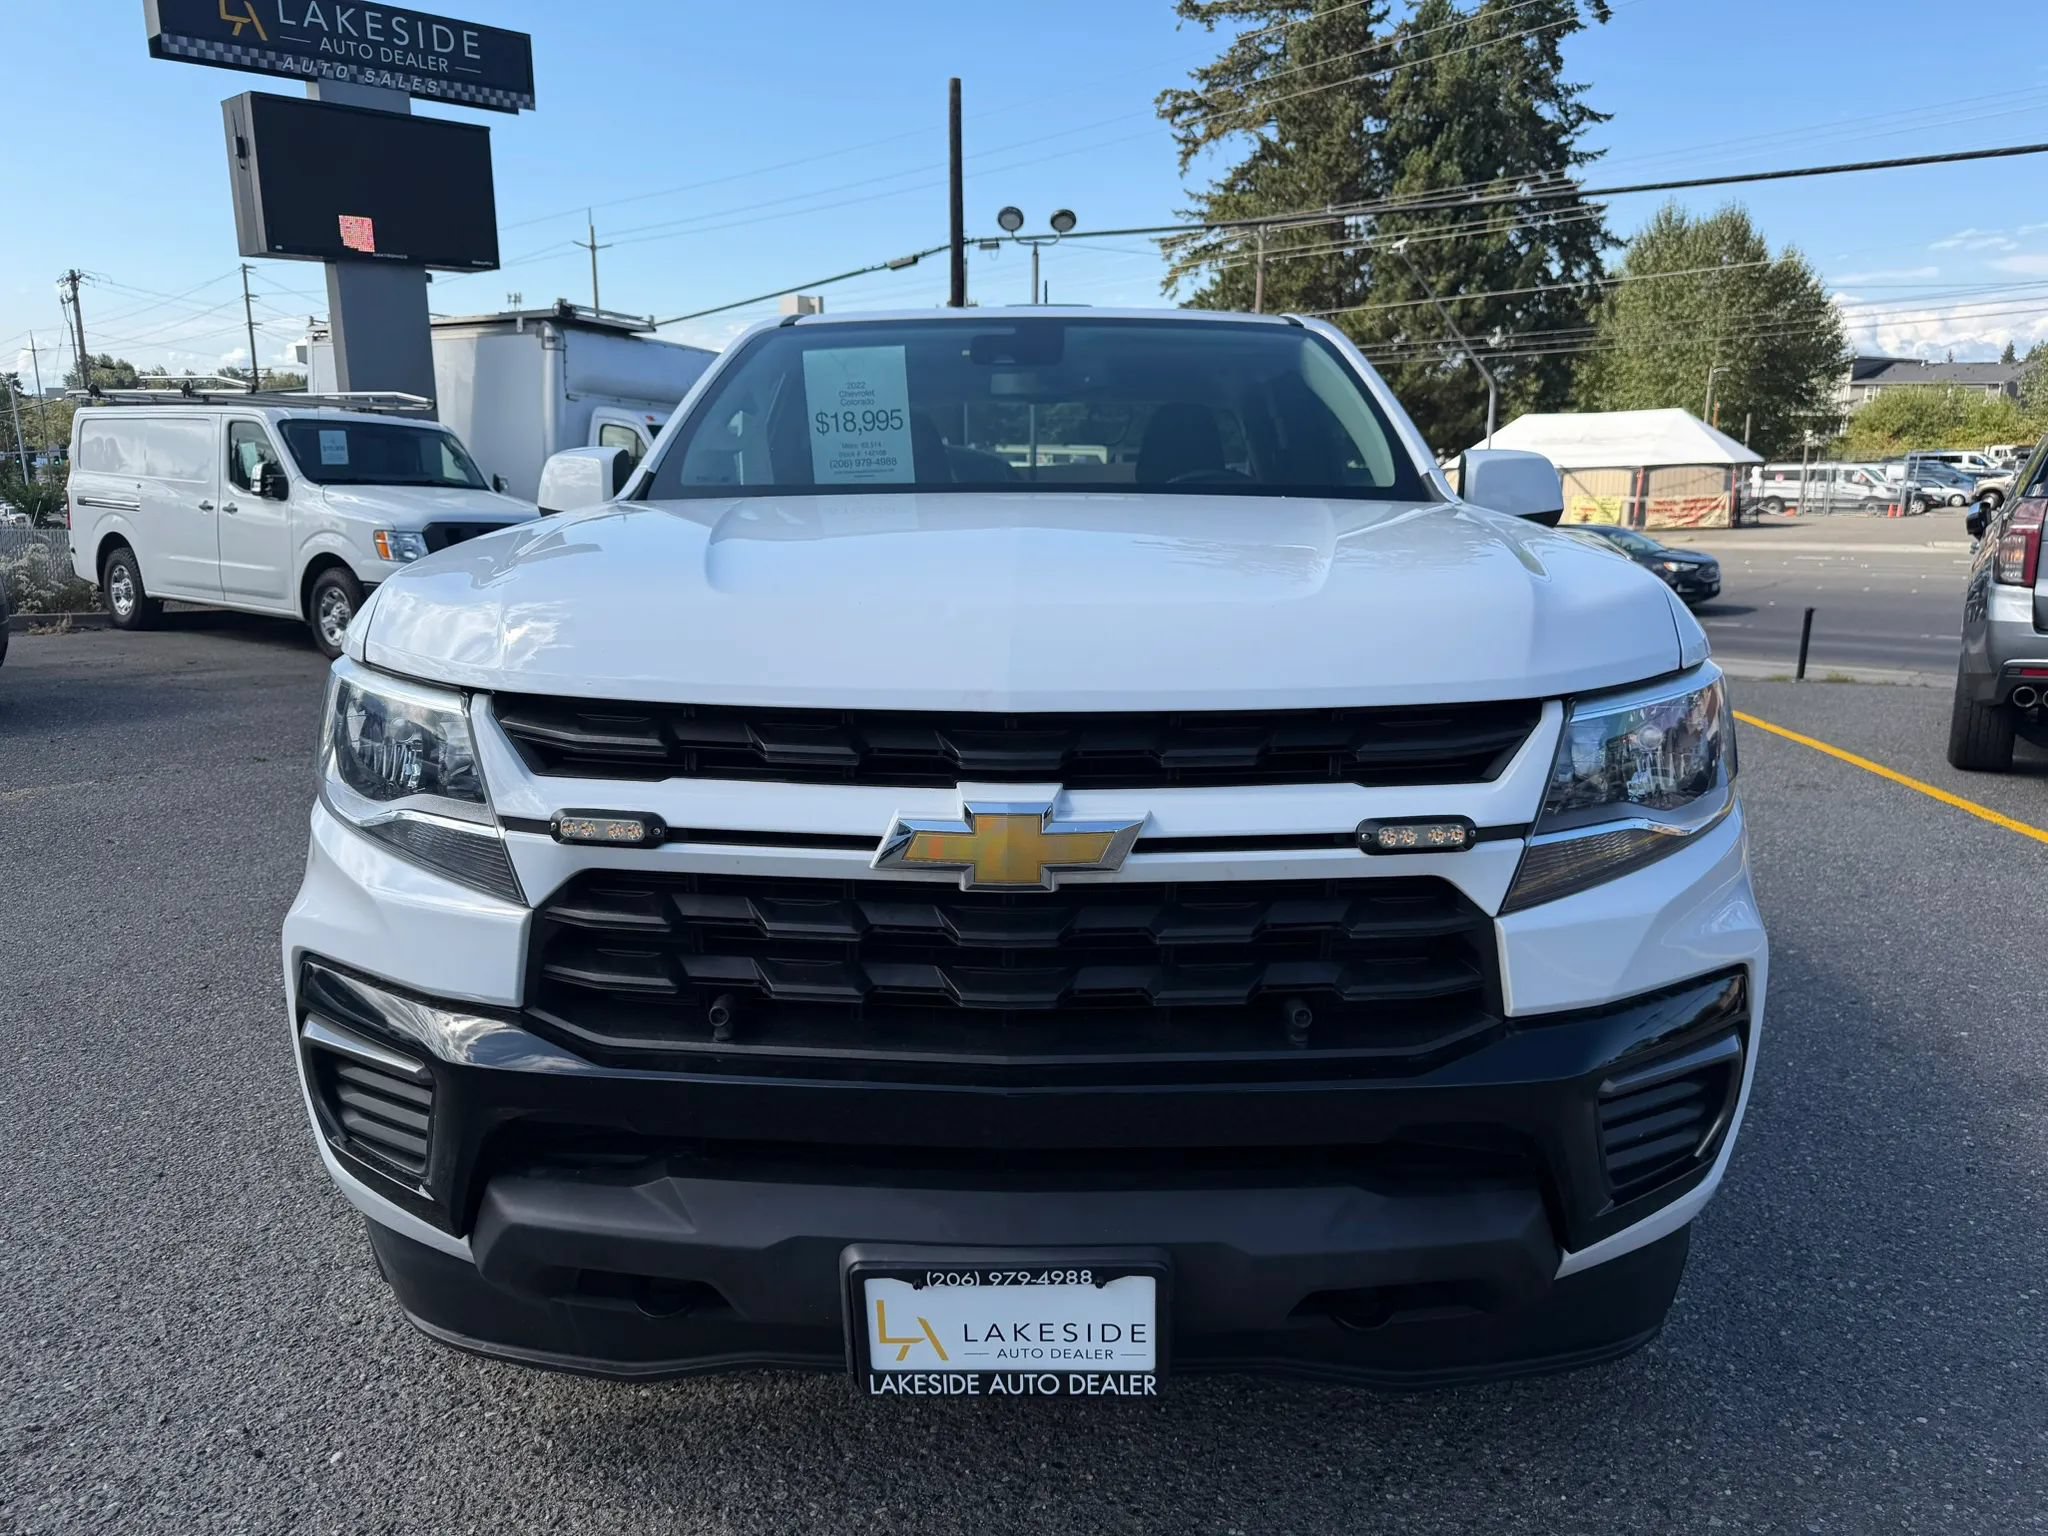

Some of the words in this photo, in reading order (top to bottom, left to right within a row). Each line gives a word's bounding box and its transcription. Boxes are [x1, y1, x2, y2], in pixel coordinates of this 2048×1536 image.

[277, 0, 481, 60] LAKESIDE
[319, 37, 373, 60] AUTO
[380, 47, 449, 73] DEALER
[281, 56, 348, 79] AUTO
[364, 70, 439, 94] SALES
[839, 389, 875, 399] Chevrolet
[840, 398, 875, 407] Colorado
[815, 409, 904, 436] $18,995
[926, 1271, 980, 1288] (206)
[988, 1269, 1093, 1287] 979-4988
[963, 1322, 1147, 1343] LAKESIDE
[996, 1347, 1044, 1360] AUTO
[1050, 1348, 1114, 1360] DEALER
[869, 1373, 980, 1396] LAKESIDE
[988, 1373, 1060, 1395] AUTO
[1069, 1373, 1158, 1396] DEALER
